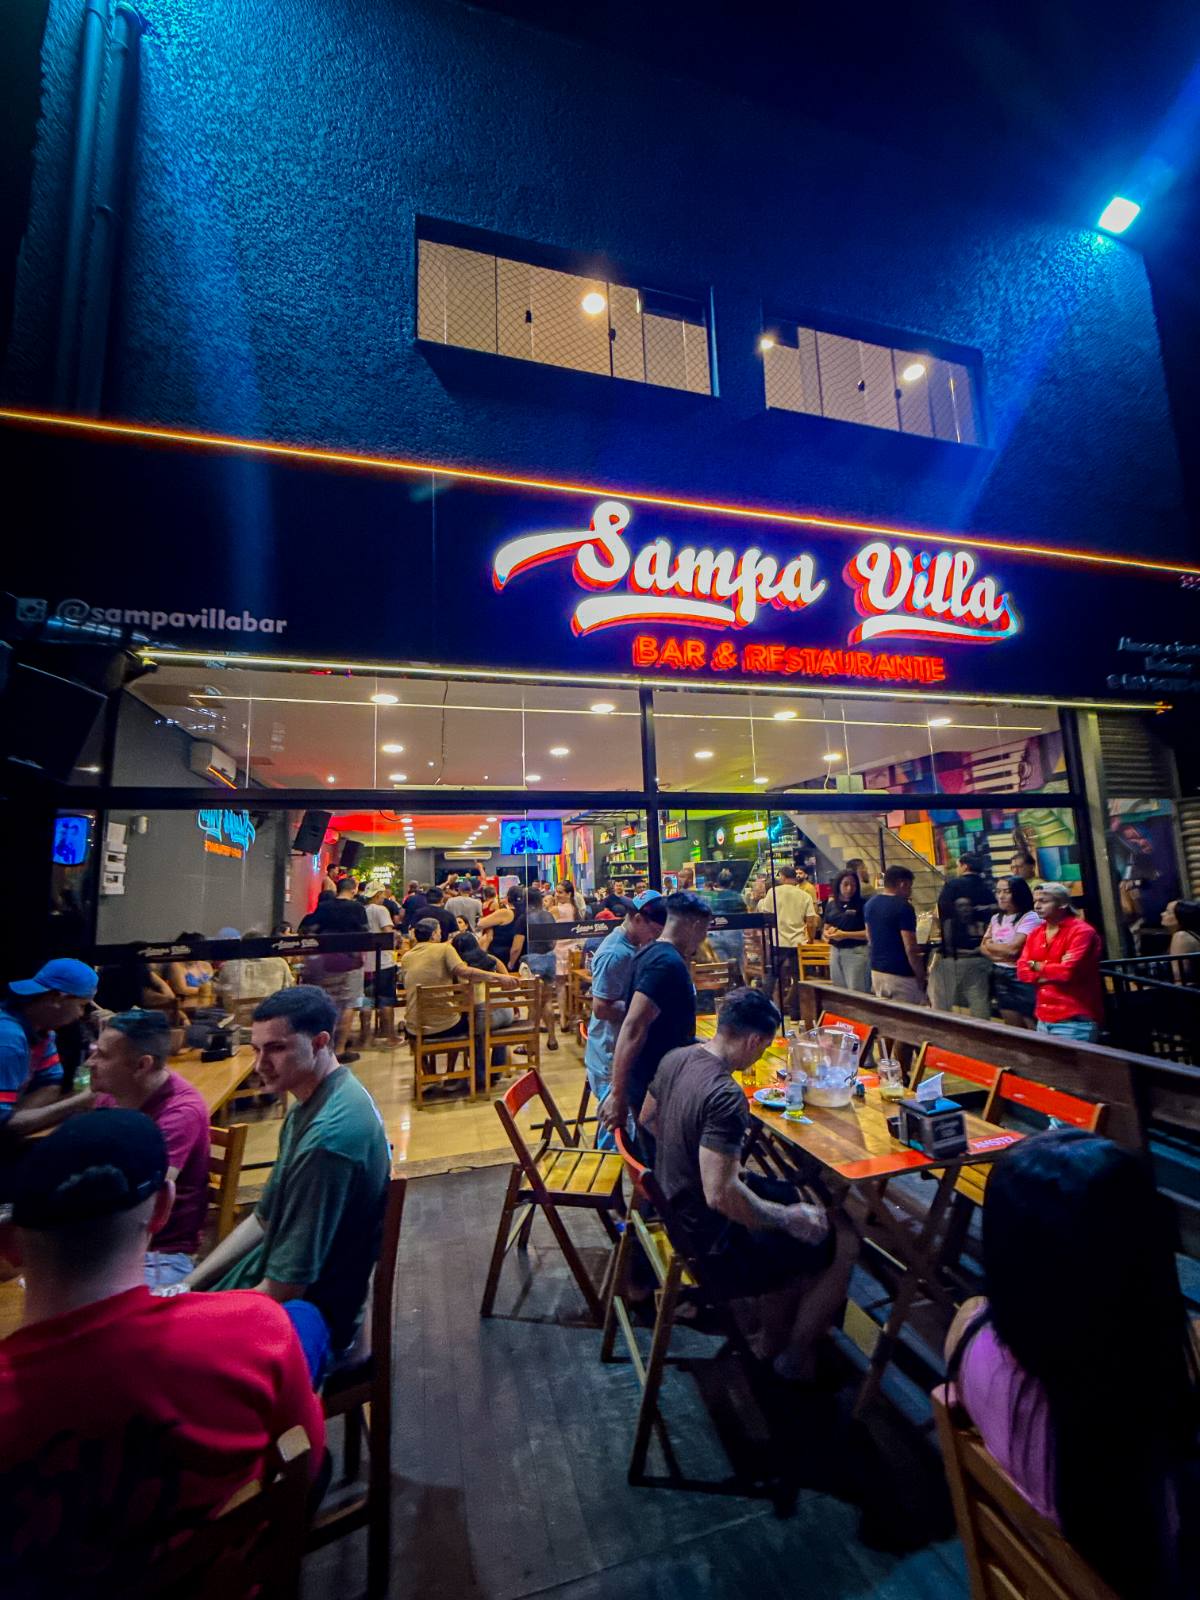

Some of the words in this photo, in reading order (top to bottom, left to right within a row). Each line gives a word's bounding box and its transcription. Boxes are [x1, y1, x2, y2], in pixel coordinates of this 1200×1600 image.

[492, 500, 827, 637] Sampa
[845, 541, 1022, 643] Villa
[57, 597, 288, 635] @sampavillabar
[633, 635, 706, 669] BAR
[713, 641, 738, 670] &
[744, 644, 947, 683] RESTAURANTE
